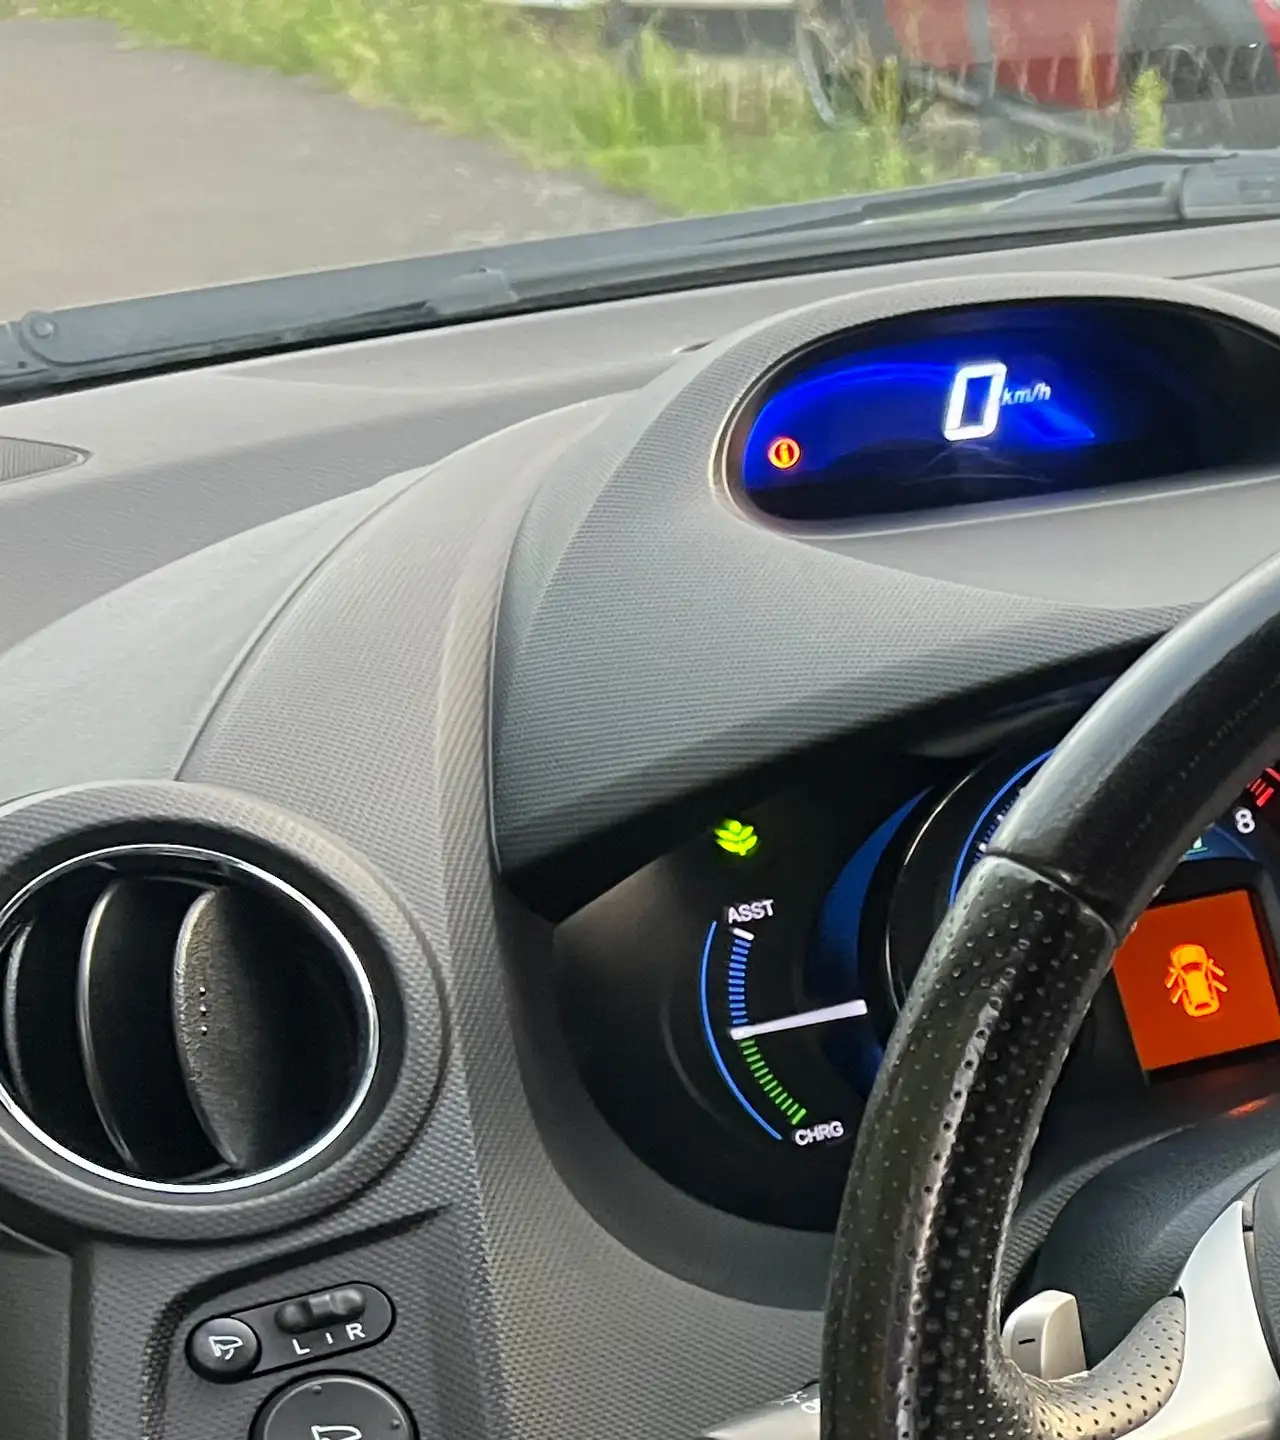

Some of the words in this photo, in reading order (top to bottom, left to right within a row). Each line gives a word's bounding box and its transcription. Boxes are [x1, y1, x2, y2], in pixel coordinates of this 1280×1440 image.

[943, 362, 1007, 441] 0
[1001, 382, 1052, 406] km/h
[1234, 808, 1256, 834] 8
[727, 899, 774, 924] ASST
[794, 1120, 844, 1146] CHRG
[293, 1338, 311, 1355] L
[345, 1322, 366, 1341] R
